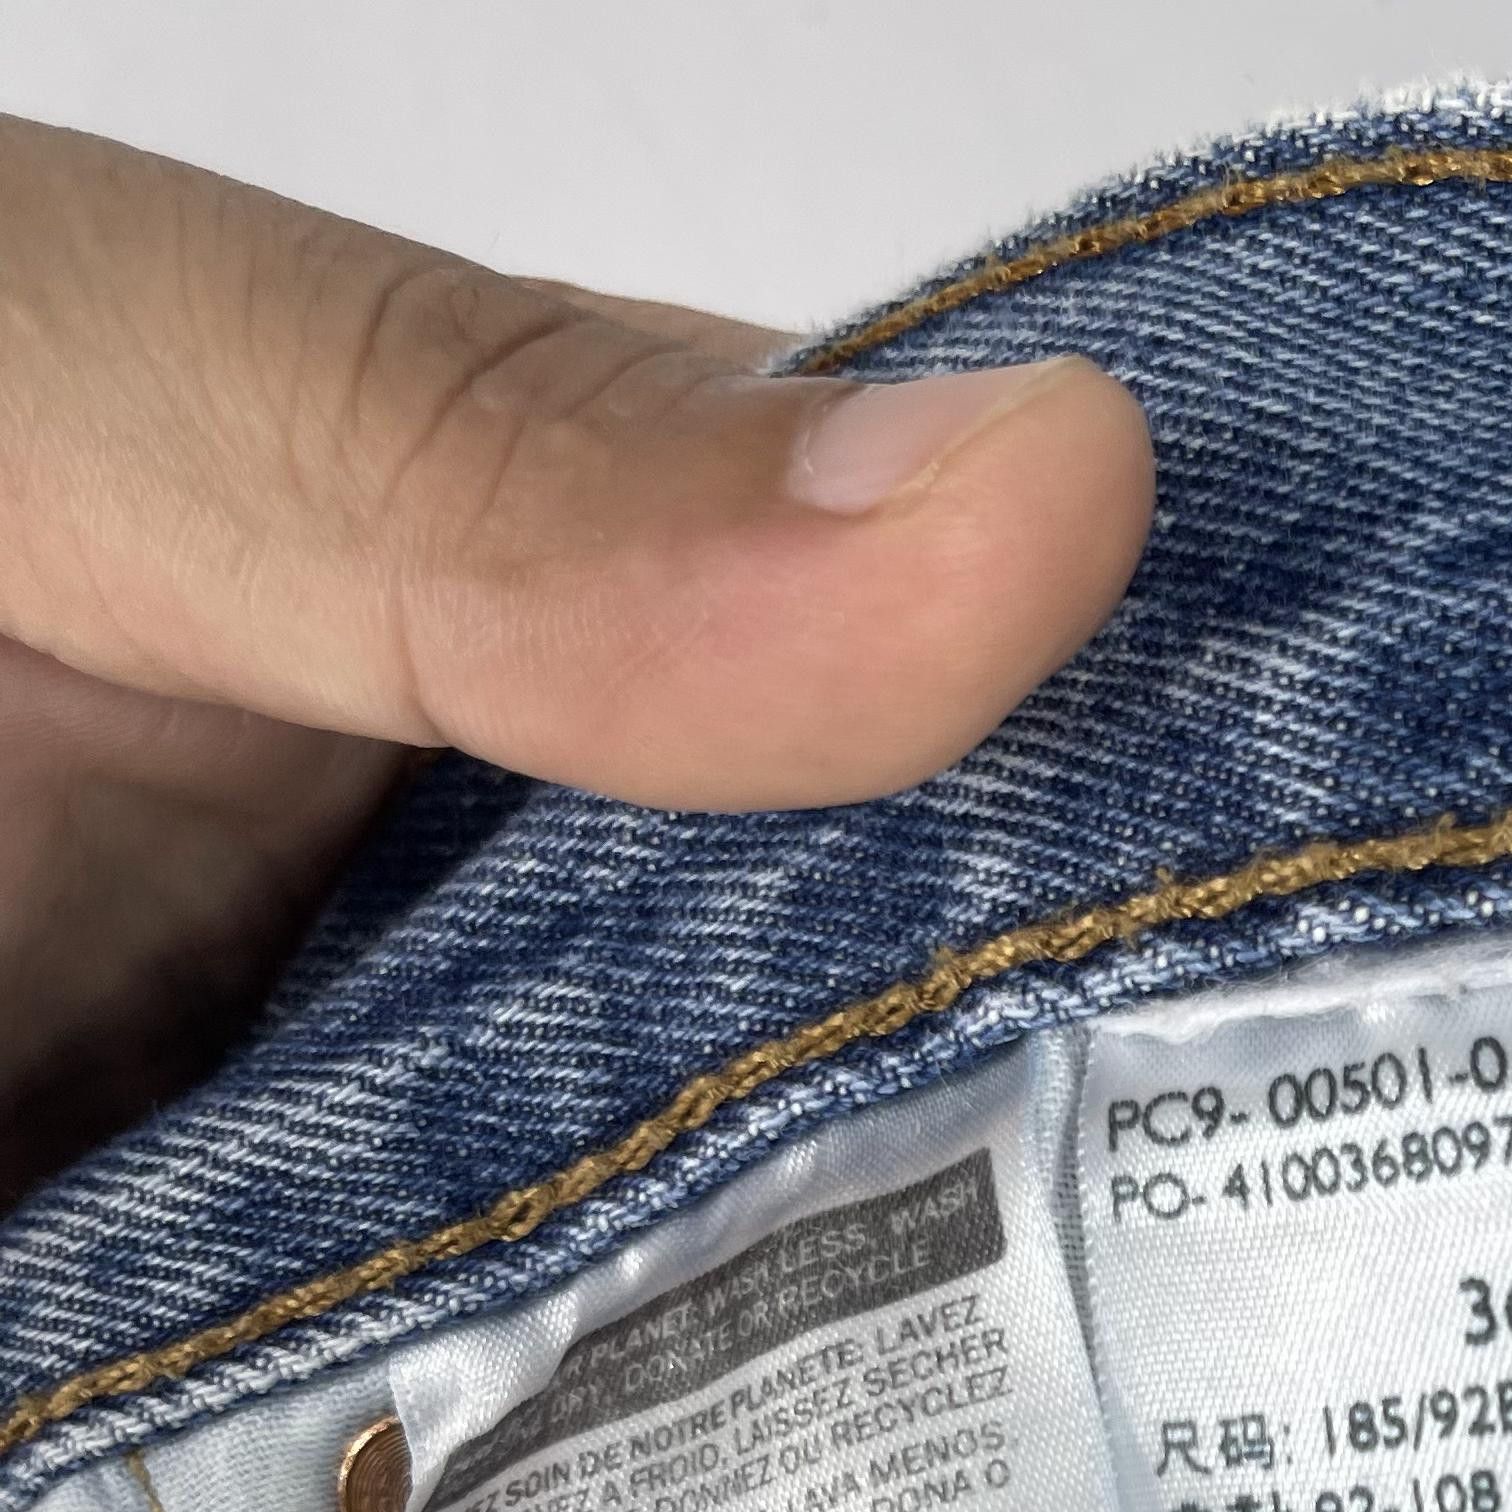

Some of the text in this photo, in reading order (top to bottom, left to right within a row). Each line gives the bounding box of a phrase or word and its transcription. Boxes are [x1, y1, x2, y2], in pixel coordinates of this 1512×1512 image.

[1107, 1084, 1249, 1152] PC9-
[890, 1176, 979, 1236] WASH
[1109, 1171, 1207, 1223] PO-
[624, 1322, 733, 1391] DONATE
[738, 1301, 773, 1338] OR
[777, 1237, 932, 1315] RECYCLE
[504, 1459, 572, 1506] SOIN
[579, 1440, 625, 1480] DE
[629, 1399, 727, 1459] NOTRE
[876, 1294, 984, 1355] LAVEZ
[733, 1378, 852, 1456] LAISSEZ
[862, 1327, 1010, 1398] SECHER
[780, 1435, 823, 1476] OU
[830, 1364, 1014, 1452] RECYCLEZ
[984, 1458, 1011, 1490] O
